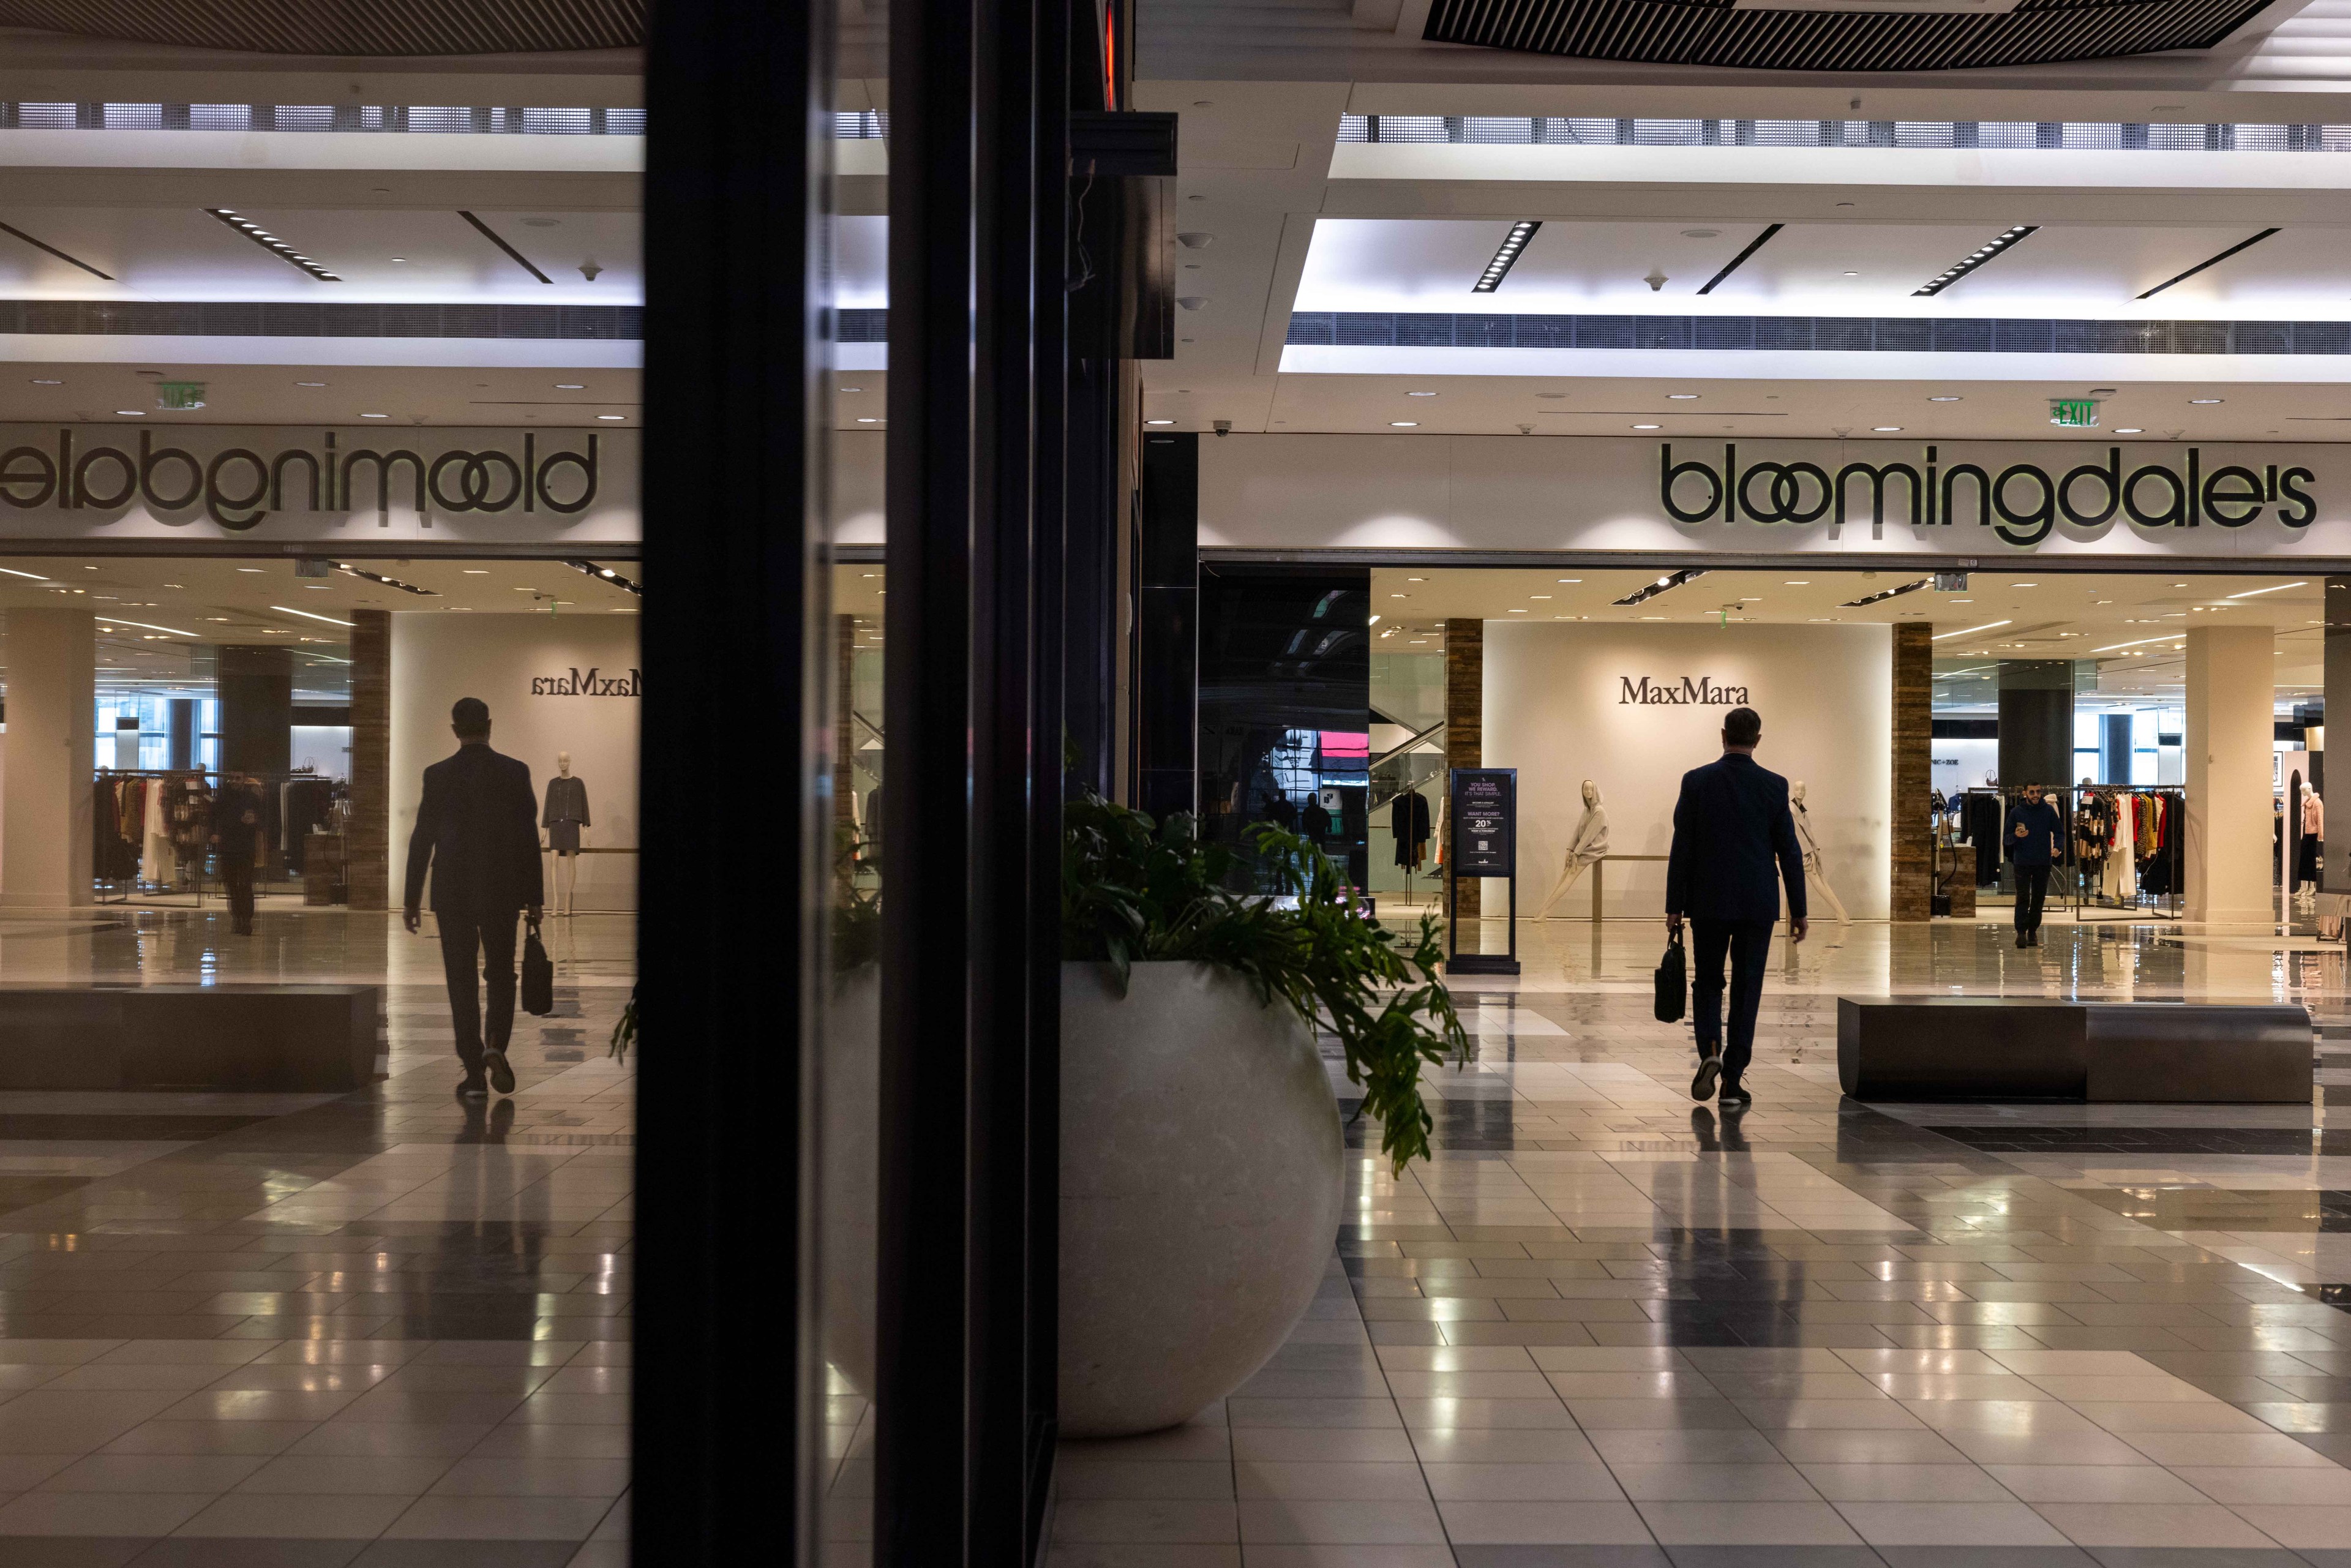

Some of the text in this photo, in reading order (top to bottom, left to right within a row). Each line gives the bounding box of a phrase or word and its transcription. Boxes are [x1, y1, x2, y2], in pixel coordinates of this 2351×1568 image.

[2059, 401, 2094, 425] EXIT
[1660, 443, 2317, 546] bloomingdale's
[1619, 676, 1749, 705] MaxMara
